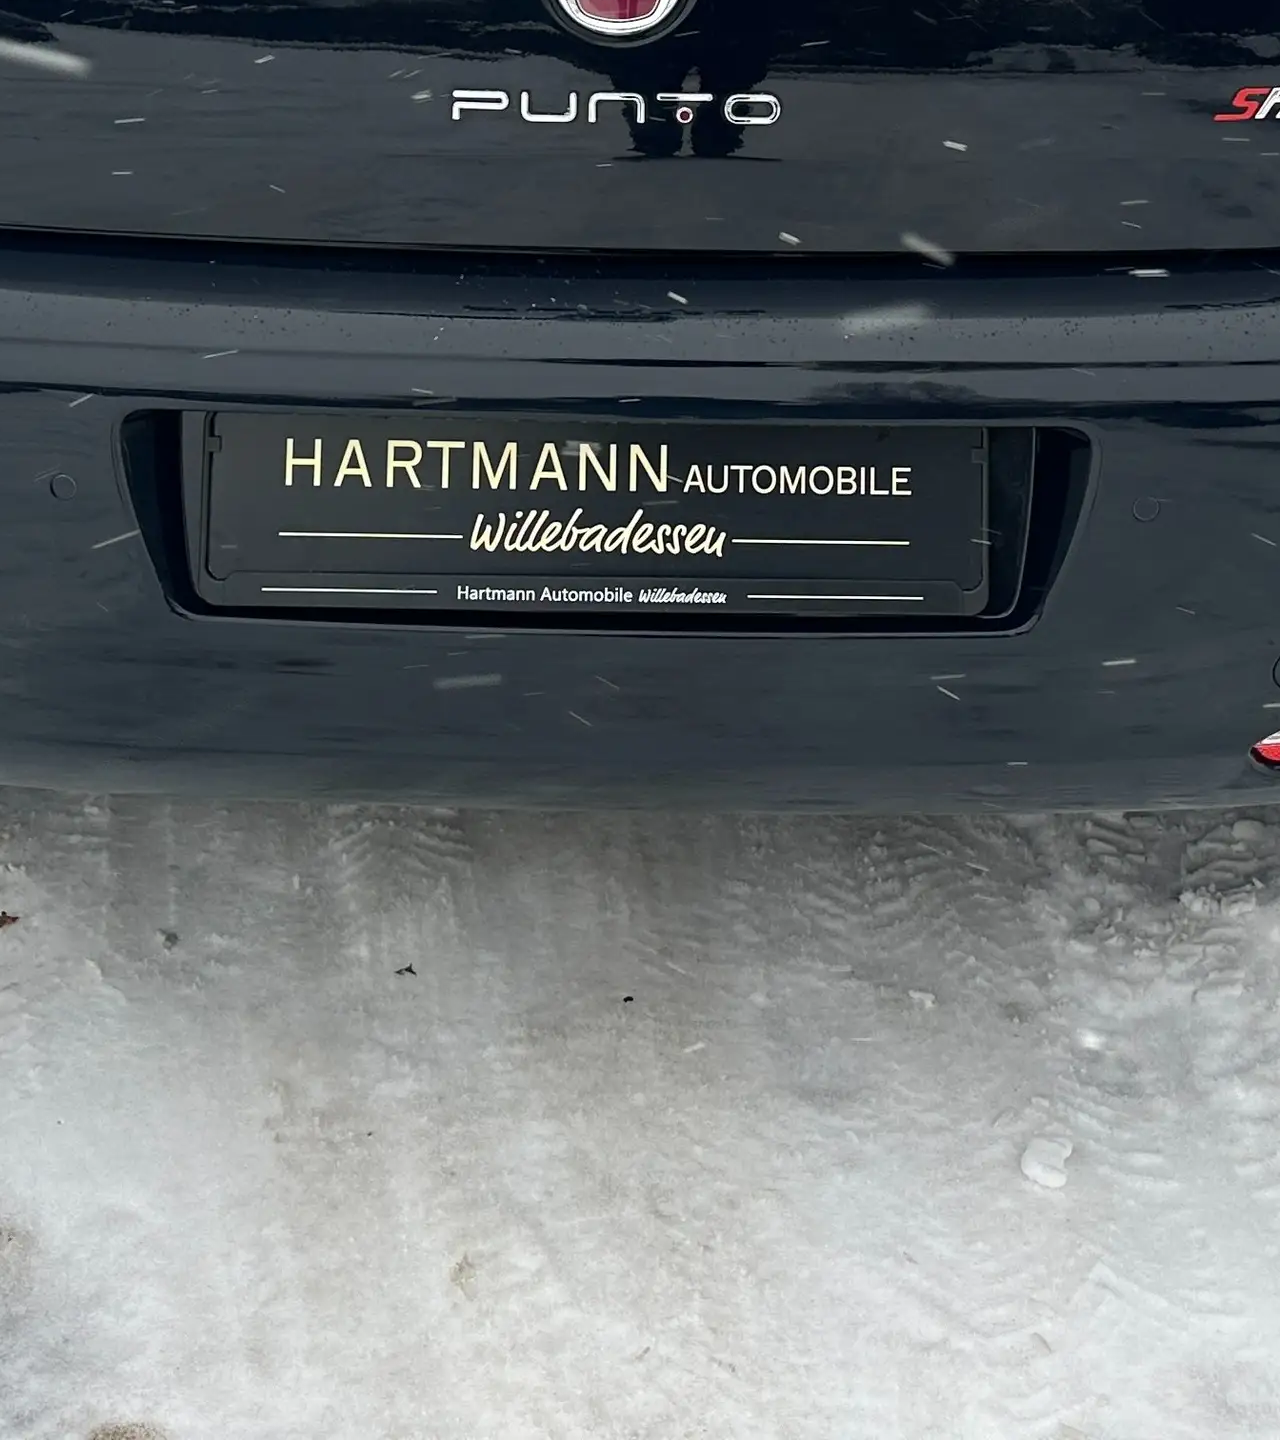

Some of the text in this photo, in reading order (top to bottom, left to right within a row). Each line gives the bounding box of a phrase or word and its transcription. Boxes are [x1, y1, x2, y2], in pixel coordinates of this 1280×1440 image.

[284, 437, 913, 496] HARTMANN AUTOMOBILE
[469, 508, 726, 558] Willebadessen
[457, 585, 728, 605] Hartmann Automobile Willebadessen
